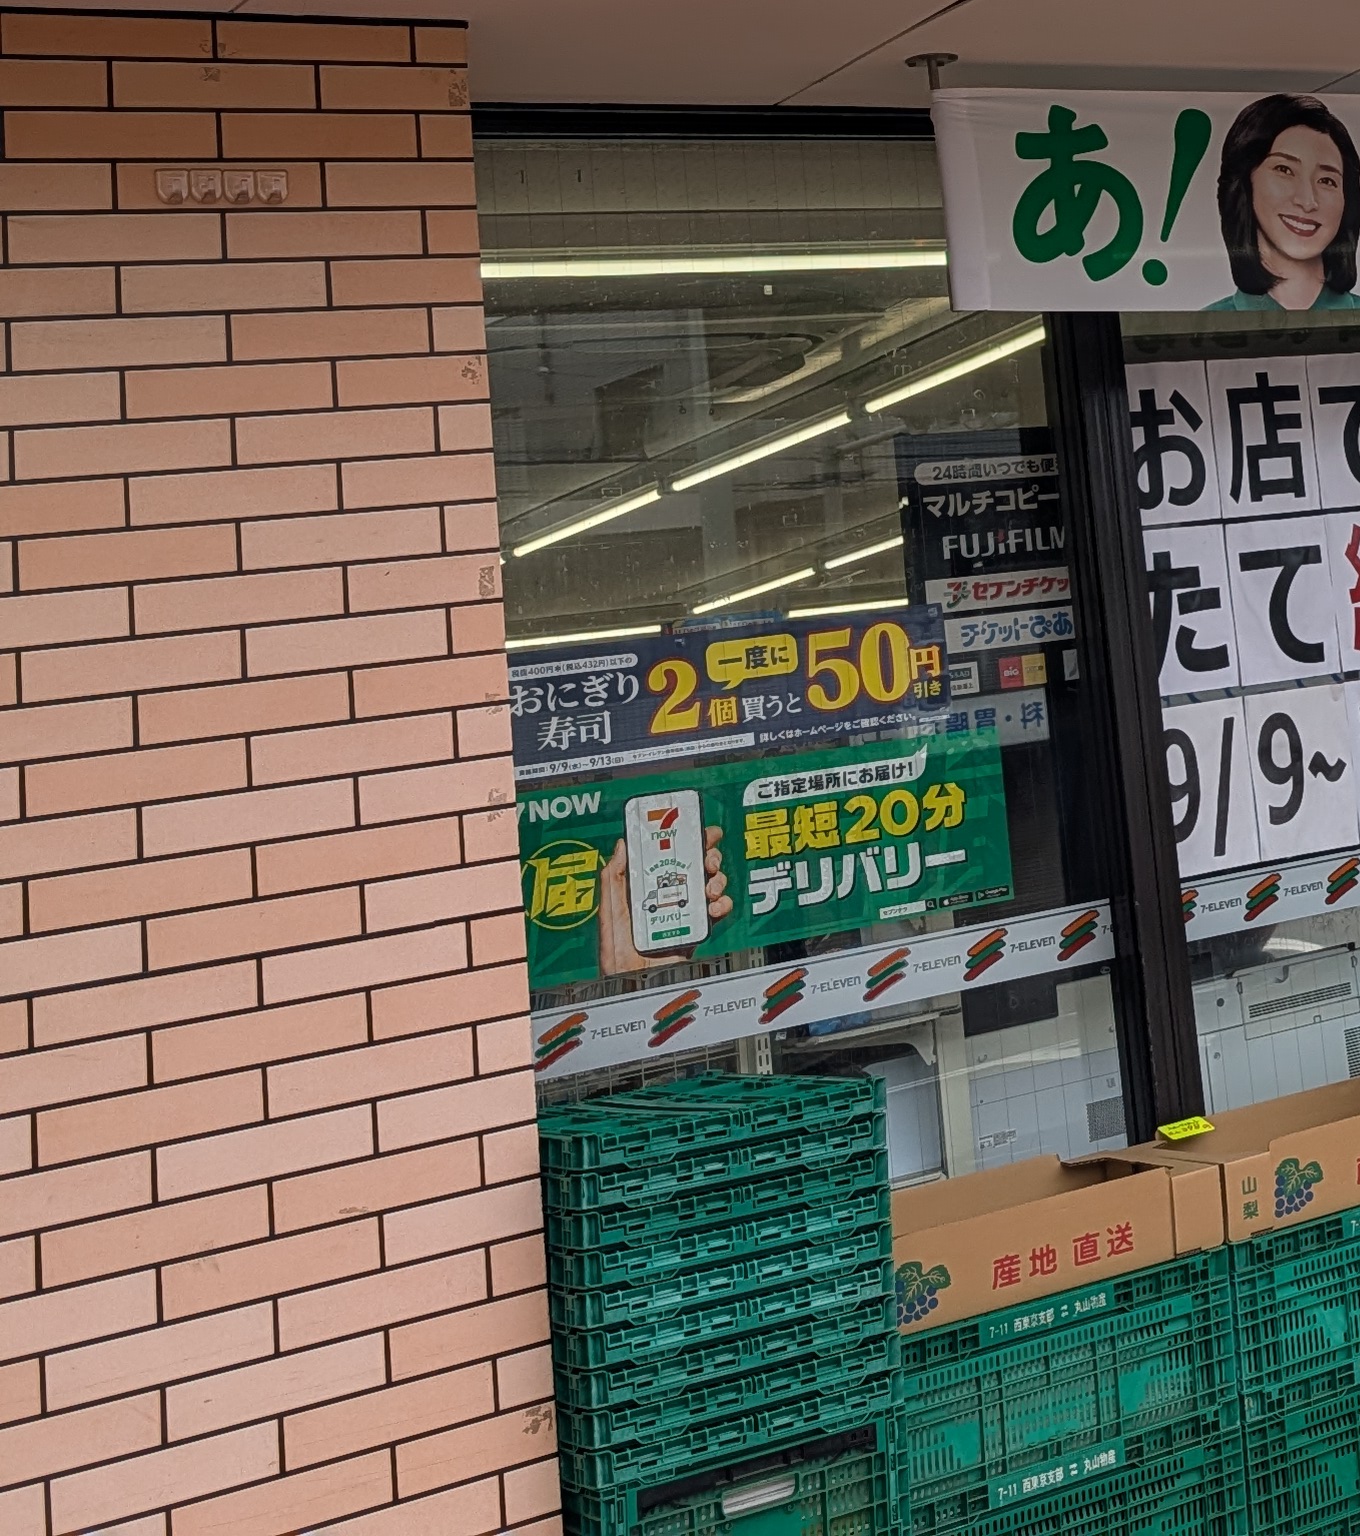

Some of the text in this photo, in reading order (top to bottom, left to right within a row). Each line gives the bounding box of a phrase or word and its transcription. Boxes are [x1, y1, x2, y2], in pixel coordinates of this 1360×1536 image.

[718, 644, 791, 670] 一度に
[510, 672, 639, 716] おにぎり
[537, 710, 612, 751] 寿司
[744, 781, 966, 861] 最短20分
[748, 841, 967, 916] デリバリー
[650, 912, 691, 926] デリバリー
[1240, 1175, 1260, 1222] 山梨
[989, 1322, 1008, 1339] 7-11
[998, 1483, 1017, 1500] 7-11
